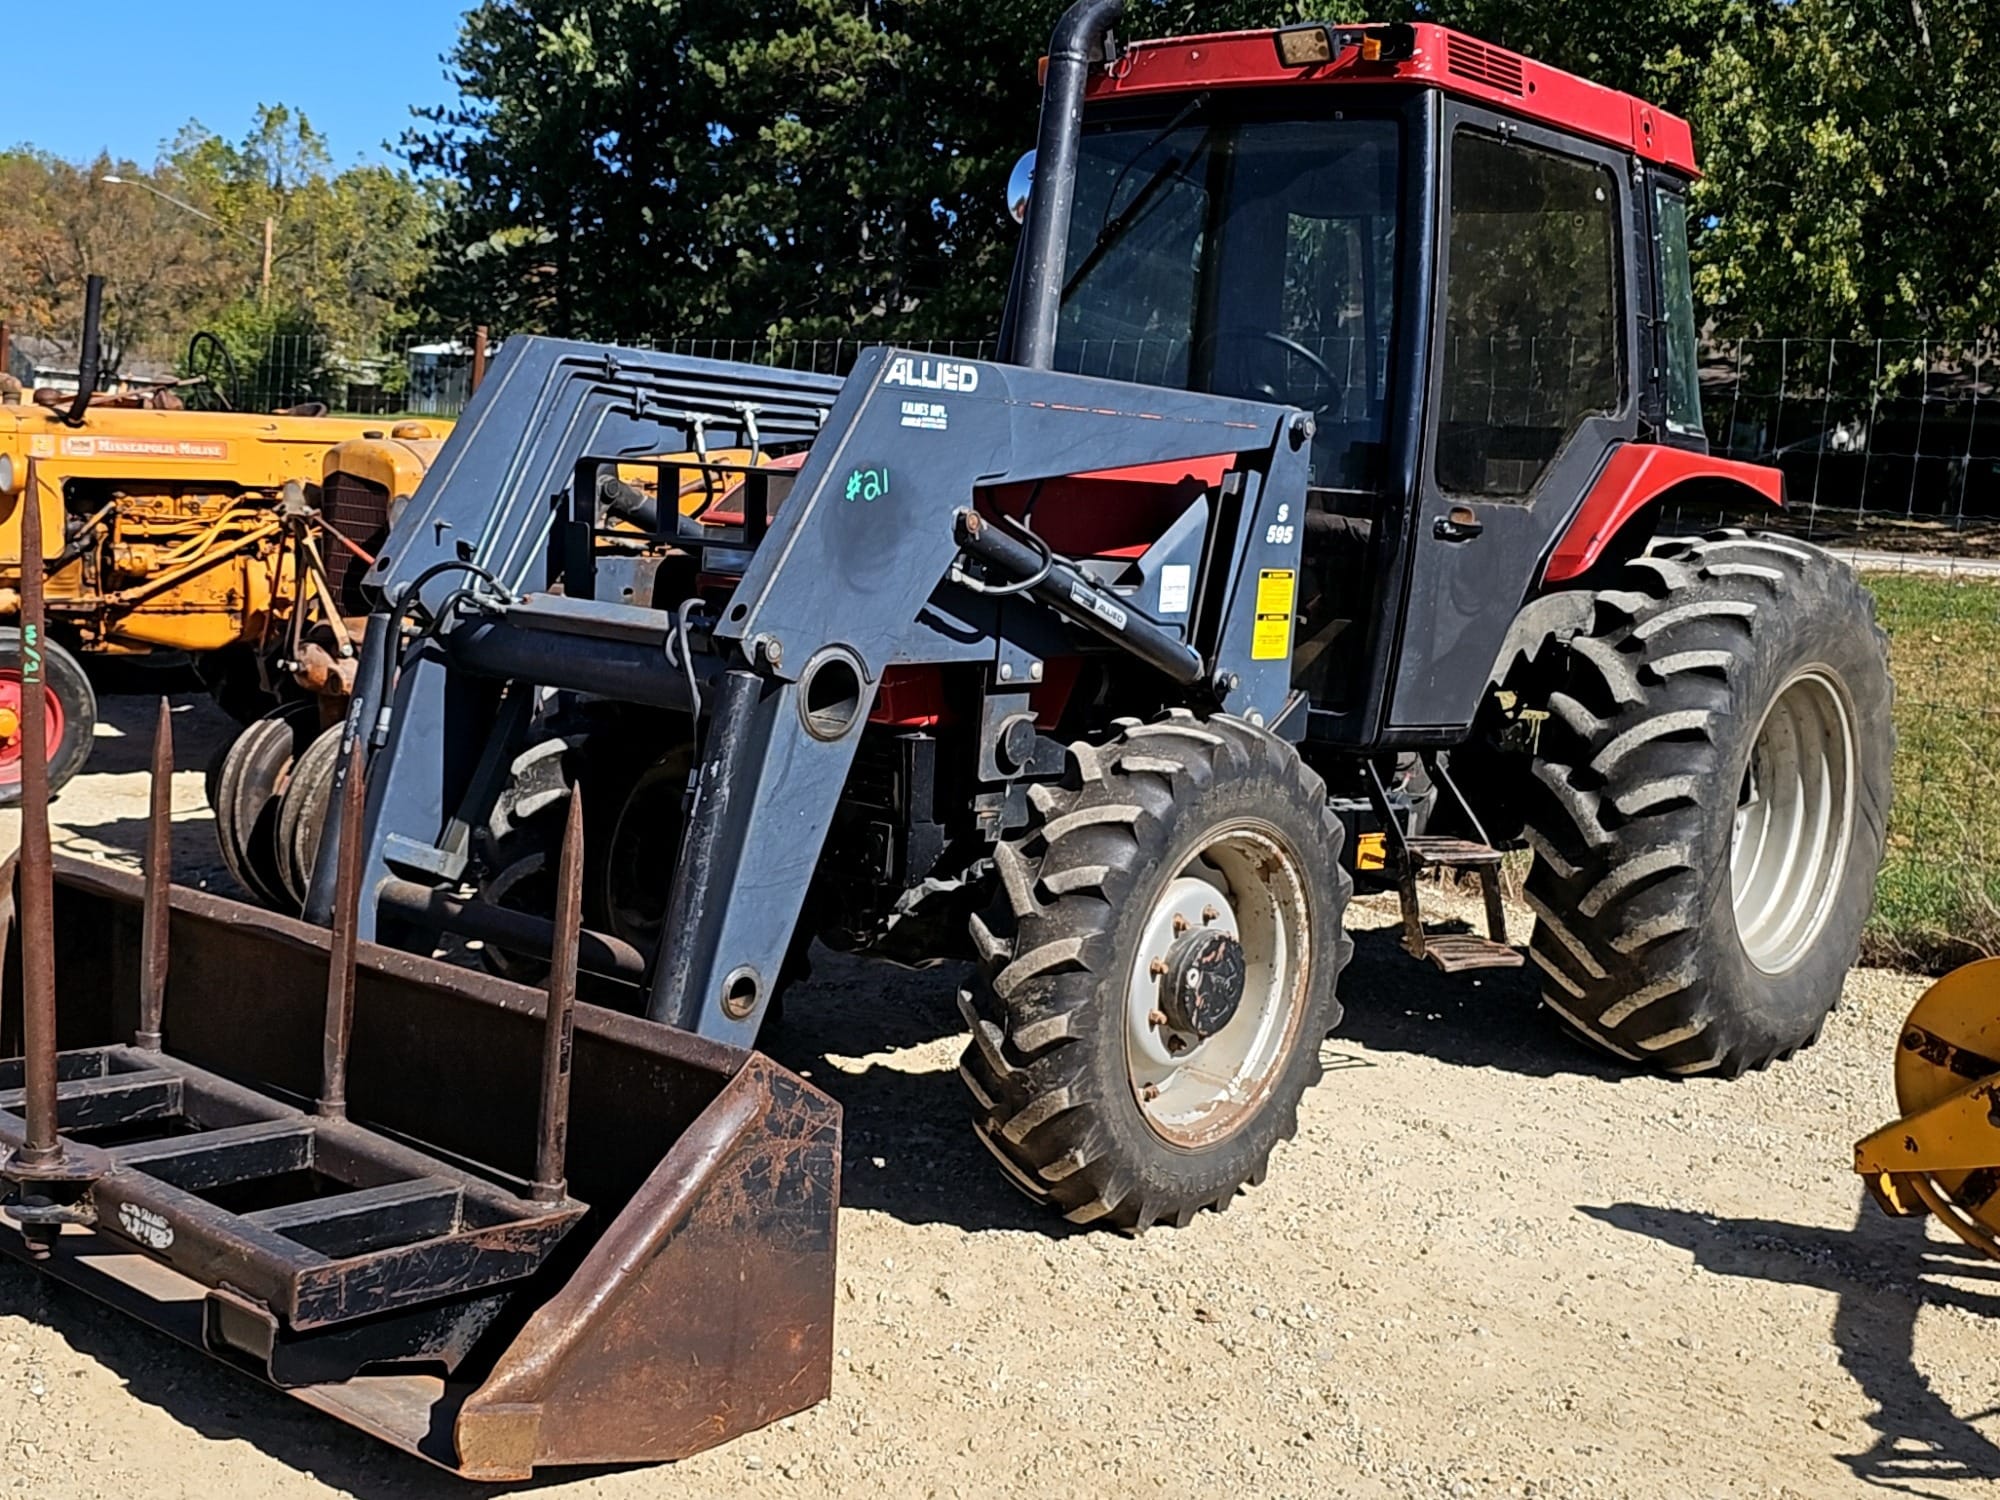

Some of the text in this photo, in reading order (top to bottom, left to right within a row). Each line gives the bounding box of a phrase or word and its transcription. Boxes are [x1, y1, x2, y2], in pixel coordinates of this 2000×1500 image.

[883, 357, 979, 393] ALLIED
[1277, 503, 1289, 523] S
[1265, 524, 1294, 544] 595
[1097, 603, 1124, 624] ALLIED
